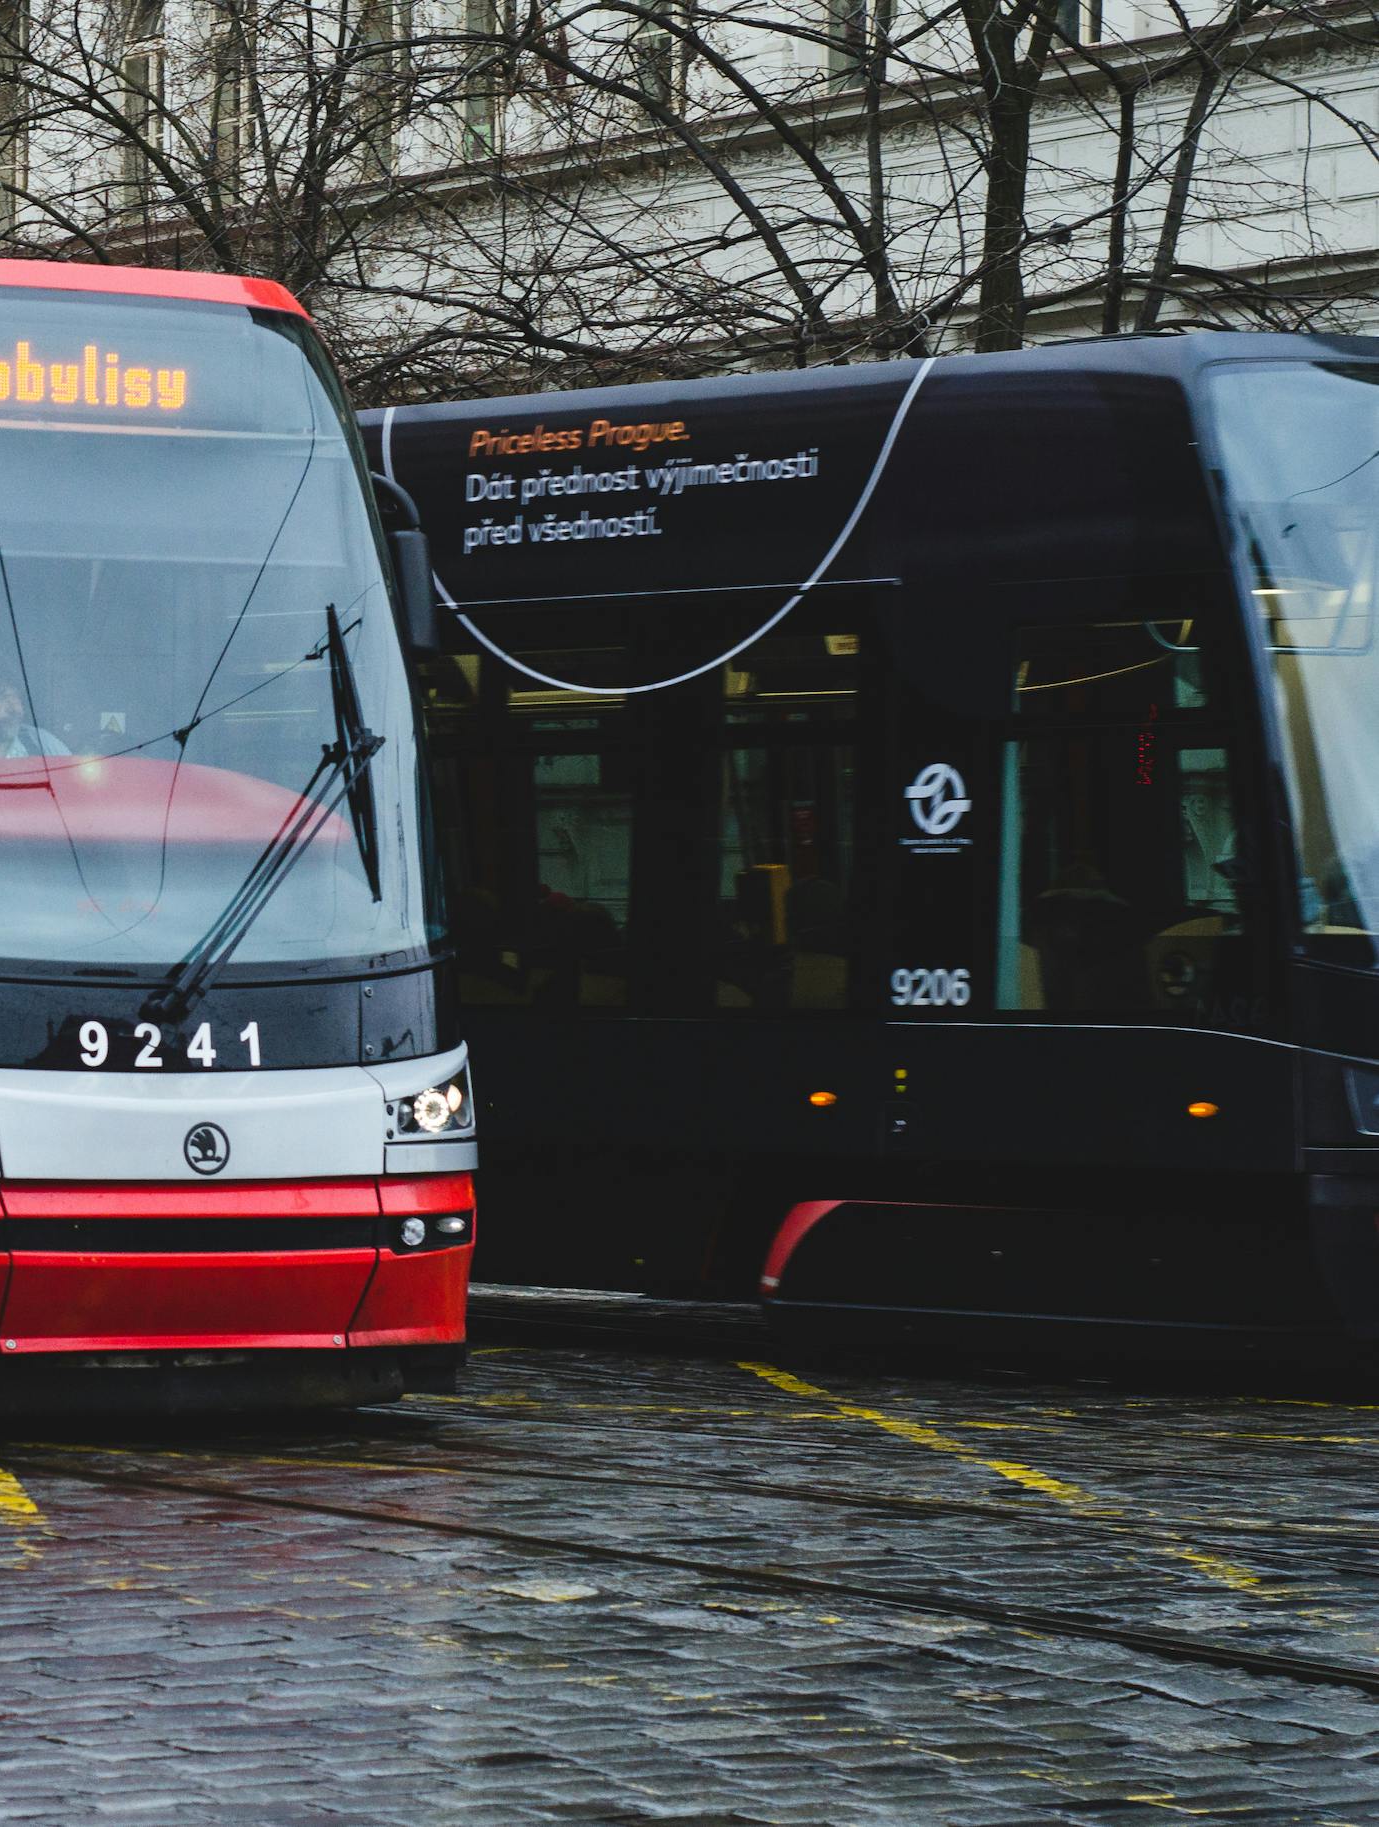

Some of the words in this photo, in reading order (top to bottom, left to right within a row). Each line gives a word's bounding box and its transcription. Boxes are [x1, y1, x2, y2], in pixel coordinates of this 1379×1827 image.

[469, 424, 583, 457] Priceless
[587, 419, 691, 451] Prague.
[465, 472, 516, 502] Dát
[521, 465, 641, 505] přednost
[645, 448, 819, 495] výjimečnosti
[463, 517, 524, 554] před
[528, 506, 663, 542] všedností.
[890, 968, 971, 1007] 9206
